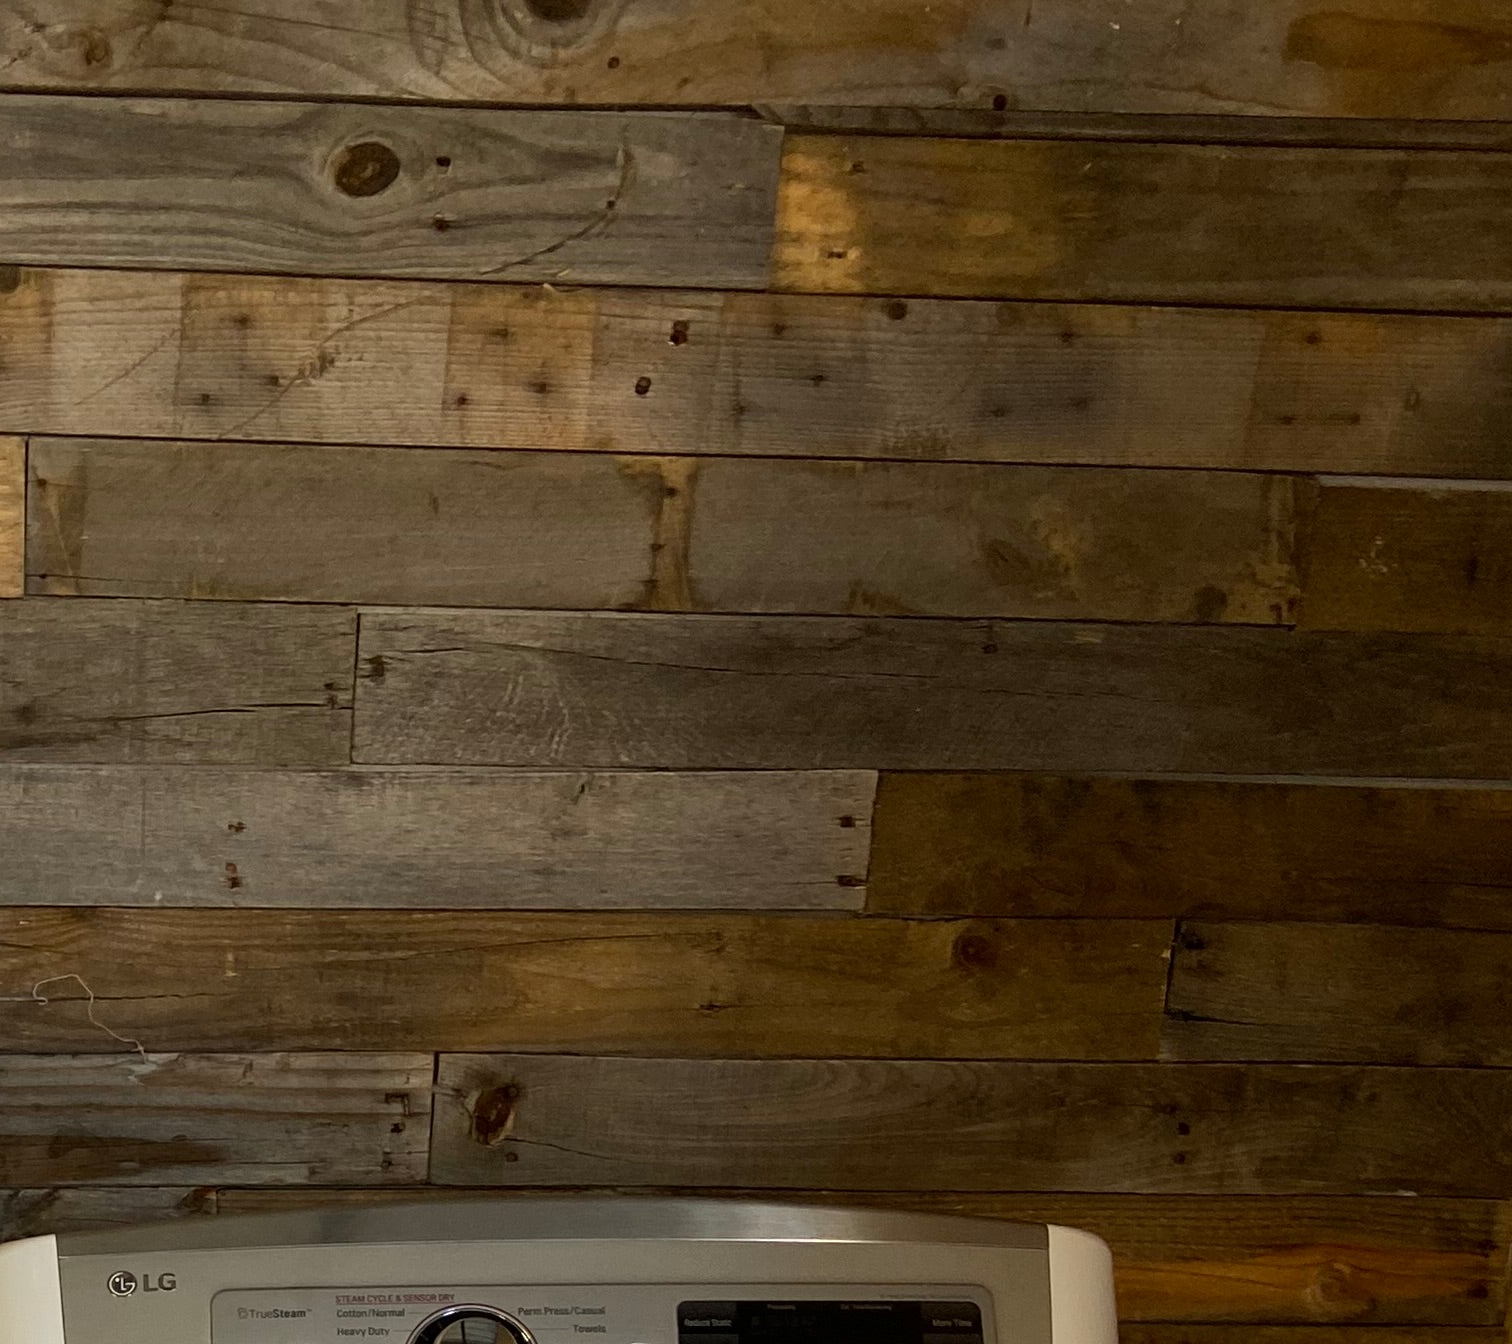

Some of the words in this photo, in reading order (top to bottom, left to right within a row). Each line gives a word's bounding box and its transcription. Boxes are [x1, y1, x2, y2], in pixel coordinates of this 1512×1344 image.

[142, 1273, 177, 1292] LG
[336, 1308, 406, 1318] Cotton/Normal
[336, 1327, 366, 1337] Heavy
[368, 1327, 390, 1337] Duty
[573, 1324, 606, 1334] Towels
